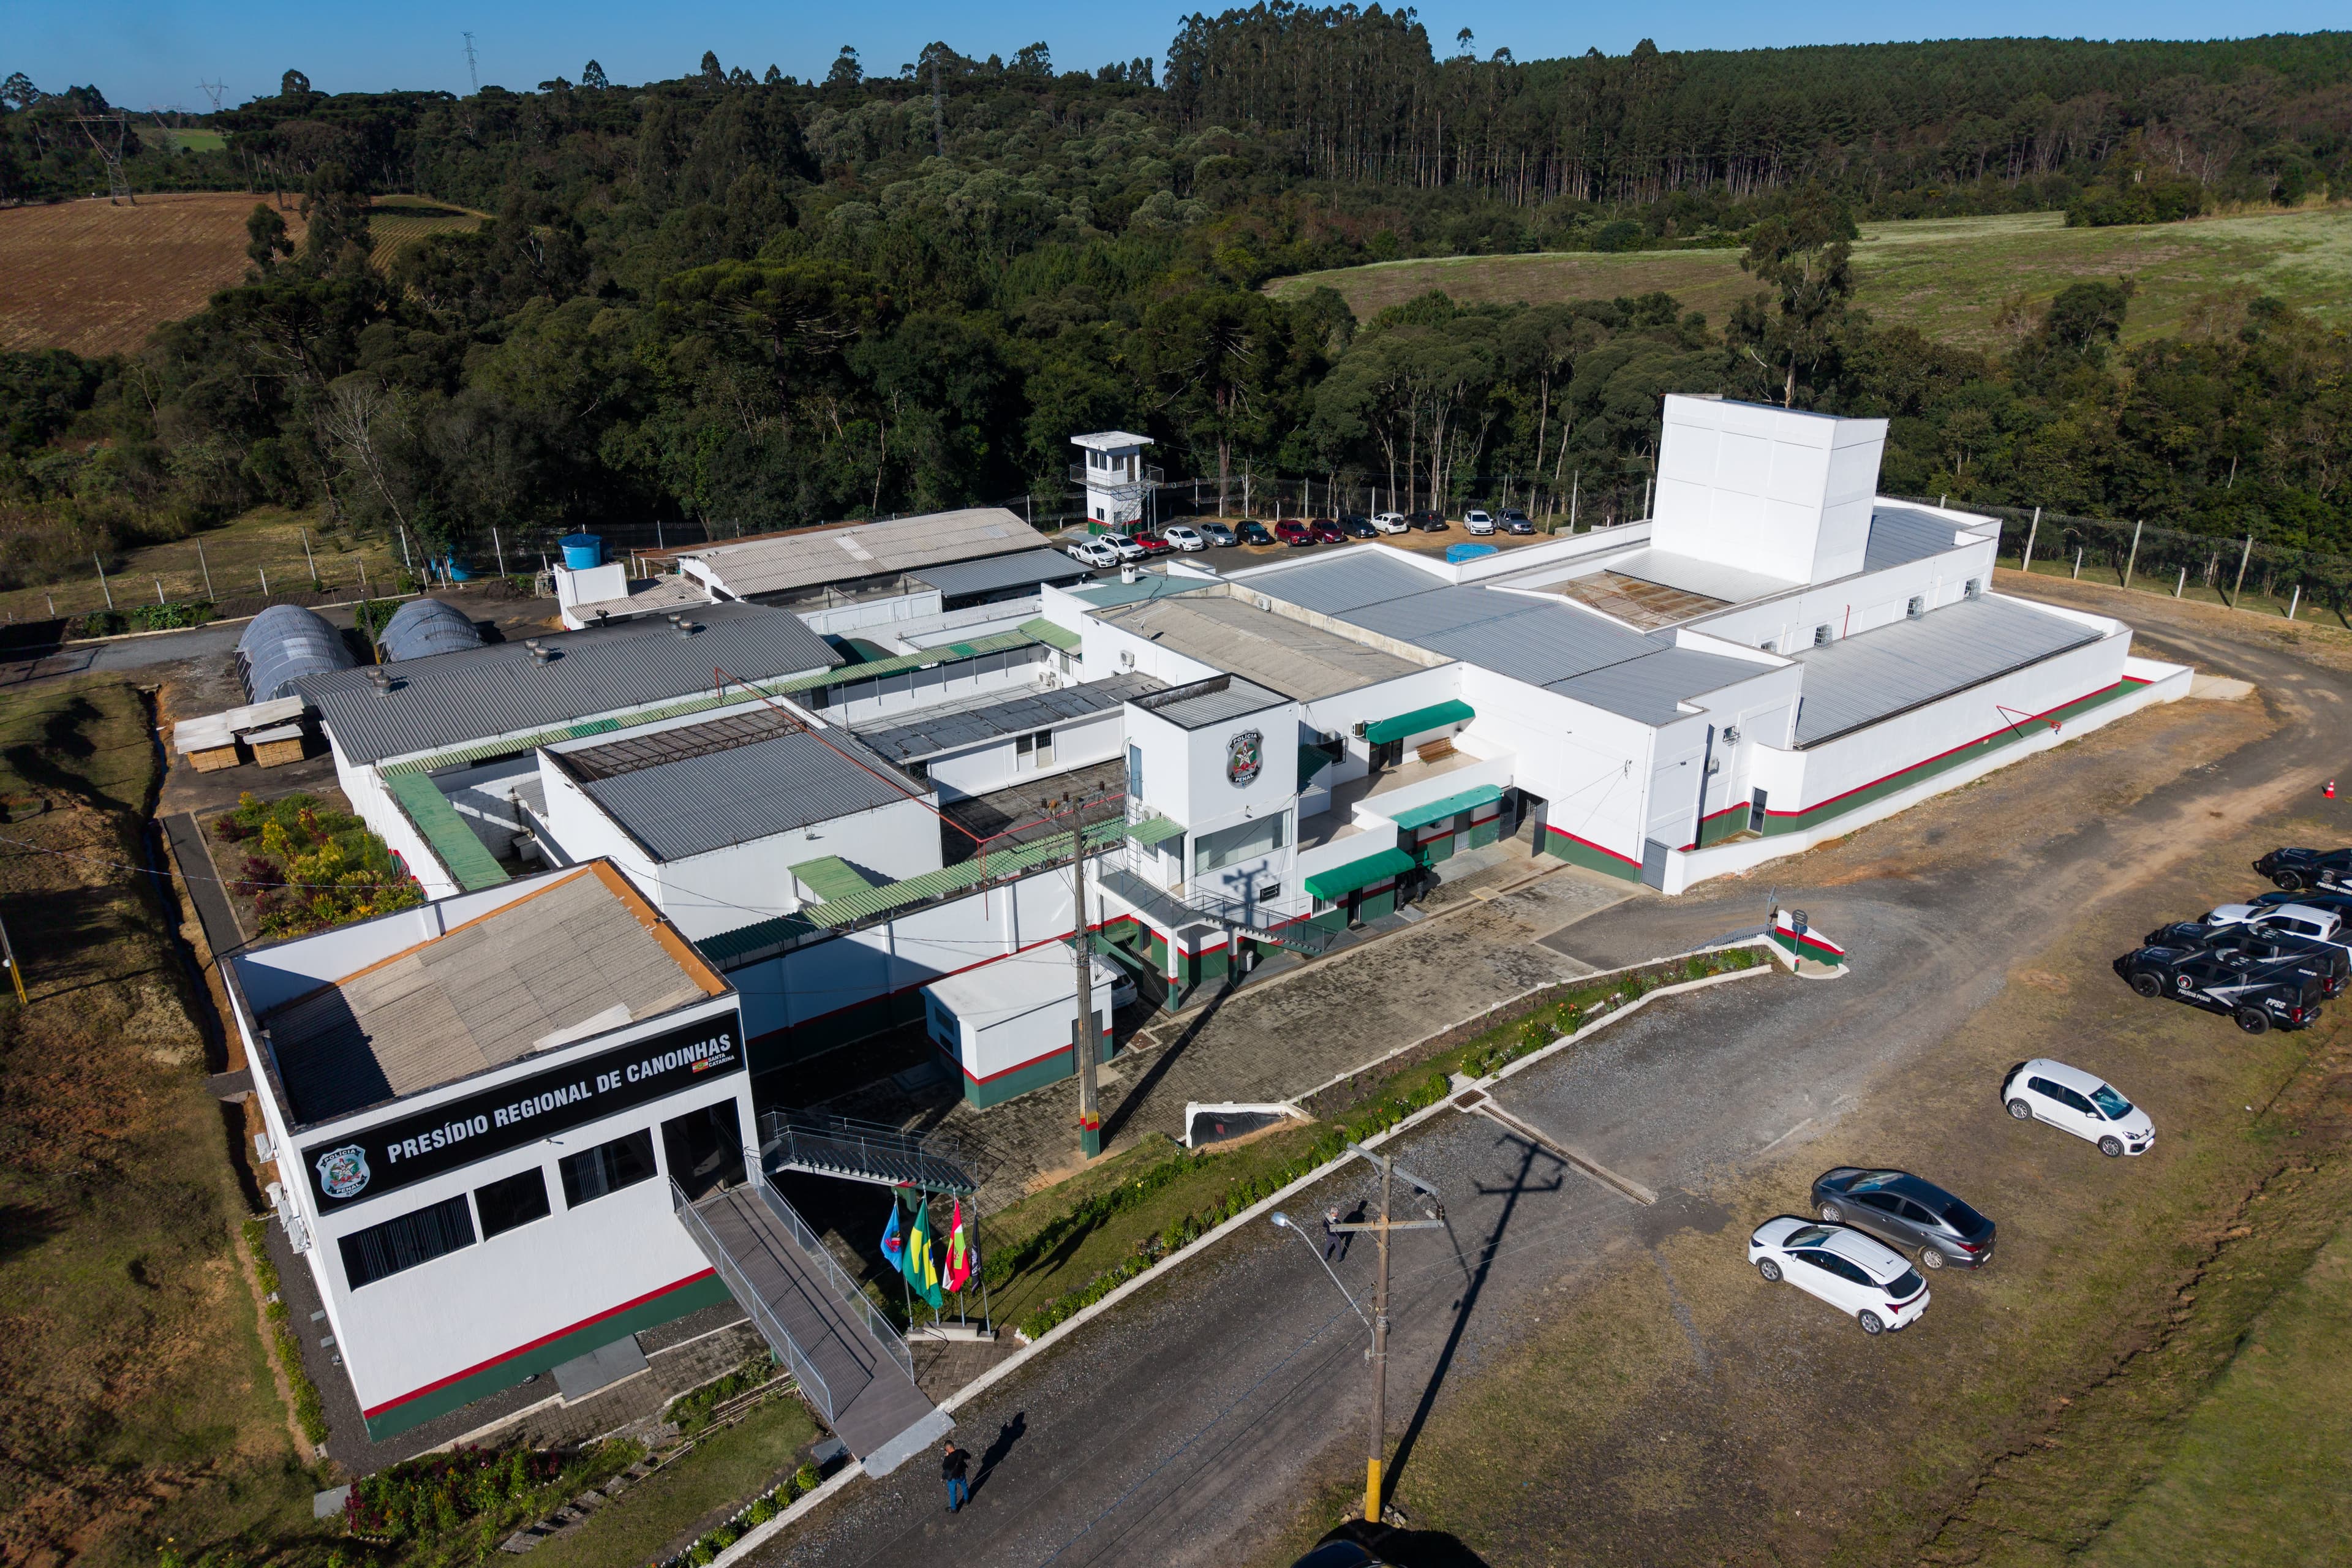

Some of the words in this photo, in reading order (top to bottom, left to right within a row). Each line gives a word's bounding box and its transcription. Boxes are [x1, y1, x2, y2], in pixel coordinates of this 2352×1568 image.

[1233, 733, 1257, 744] POLÍCIA
[1235, 774, 1254, 783] PENAL
[708, 1053, 726, 1063] SANTA
[708, 1055, 735, 1068] CATARINA
[387, 1114, 489, 1164] PRESÍDIO
[494, 1081, 592, 1128] REGIONAL
[597, 1070, 622, 1093] DE
[627, 1034, 731, 1083] CANOINHAS
[324, 1149, 356, 1163] POLÍCIA
[336, 1183, 361, 1194] PENAL
